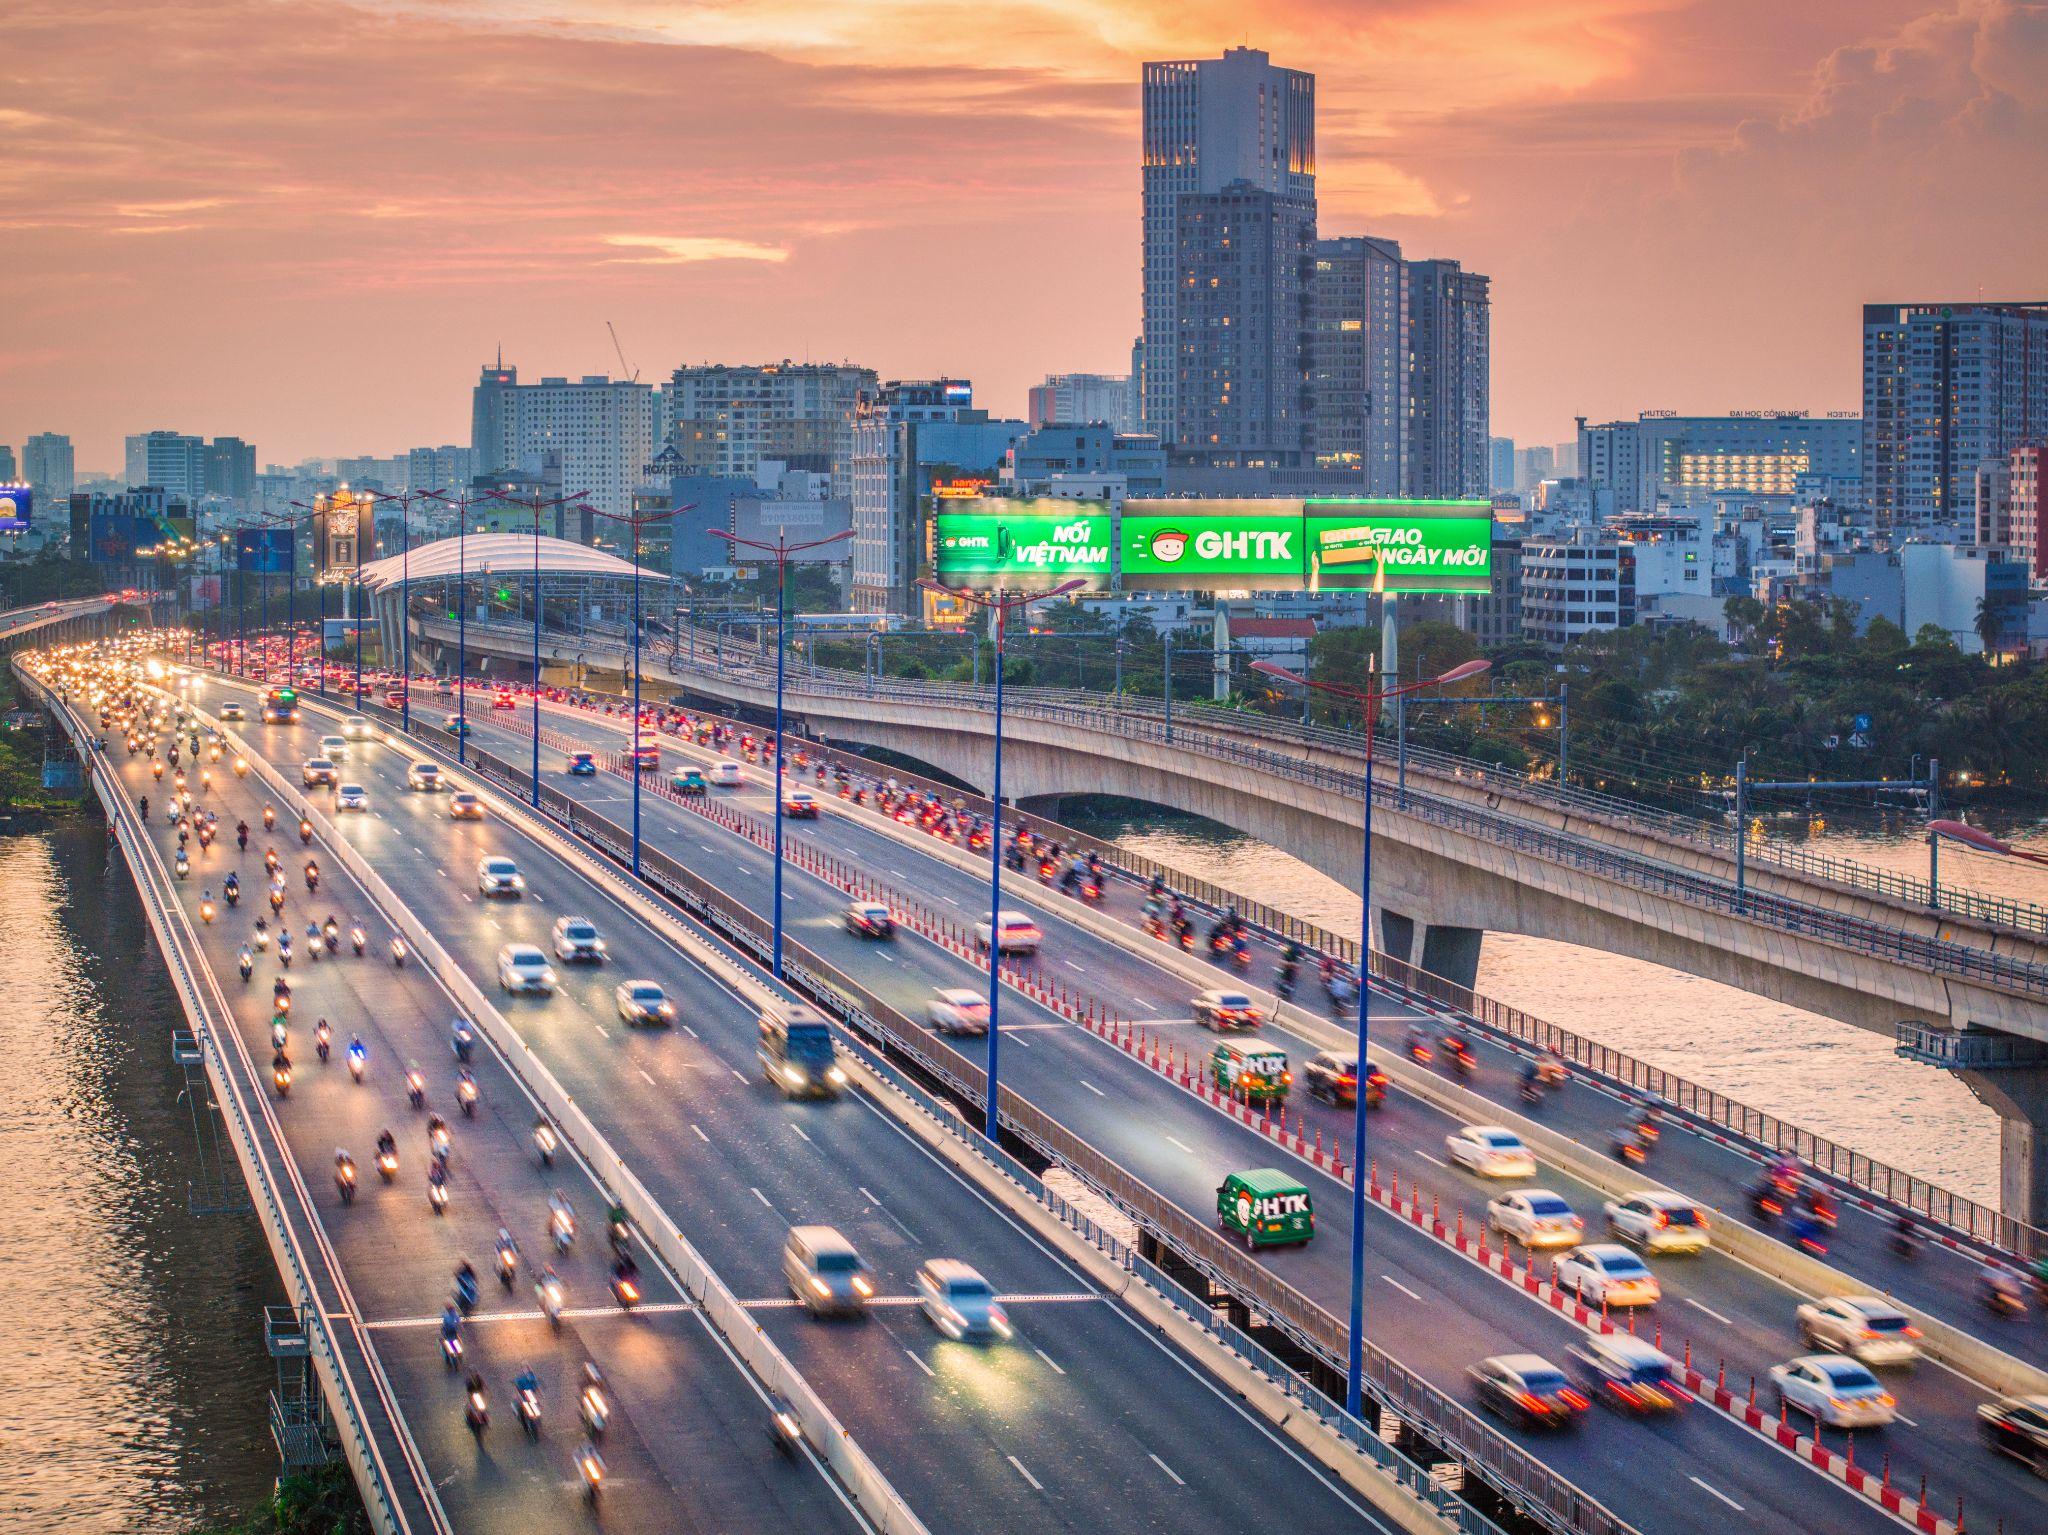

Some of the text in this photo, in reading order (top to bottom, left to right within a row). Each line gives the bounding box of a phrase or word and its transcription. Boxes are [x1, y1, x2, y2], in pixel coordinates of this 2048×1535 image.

[959, 537, 989, 548] GHTK
[1053, 520, 1091, 543] NỐI
[1370, 528, 1423, 545] GIAO
[1195, 531, 1293, 560] GHTK
[1381, 544, 1488, 566] NGÀY MỚI
